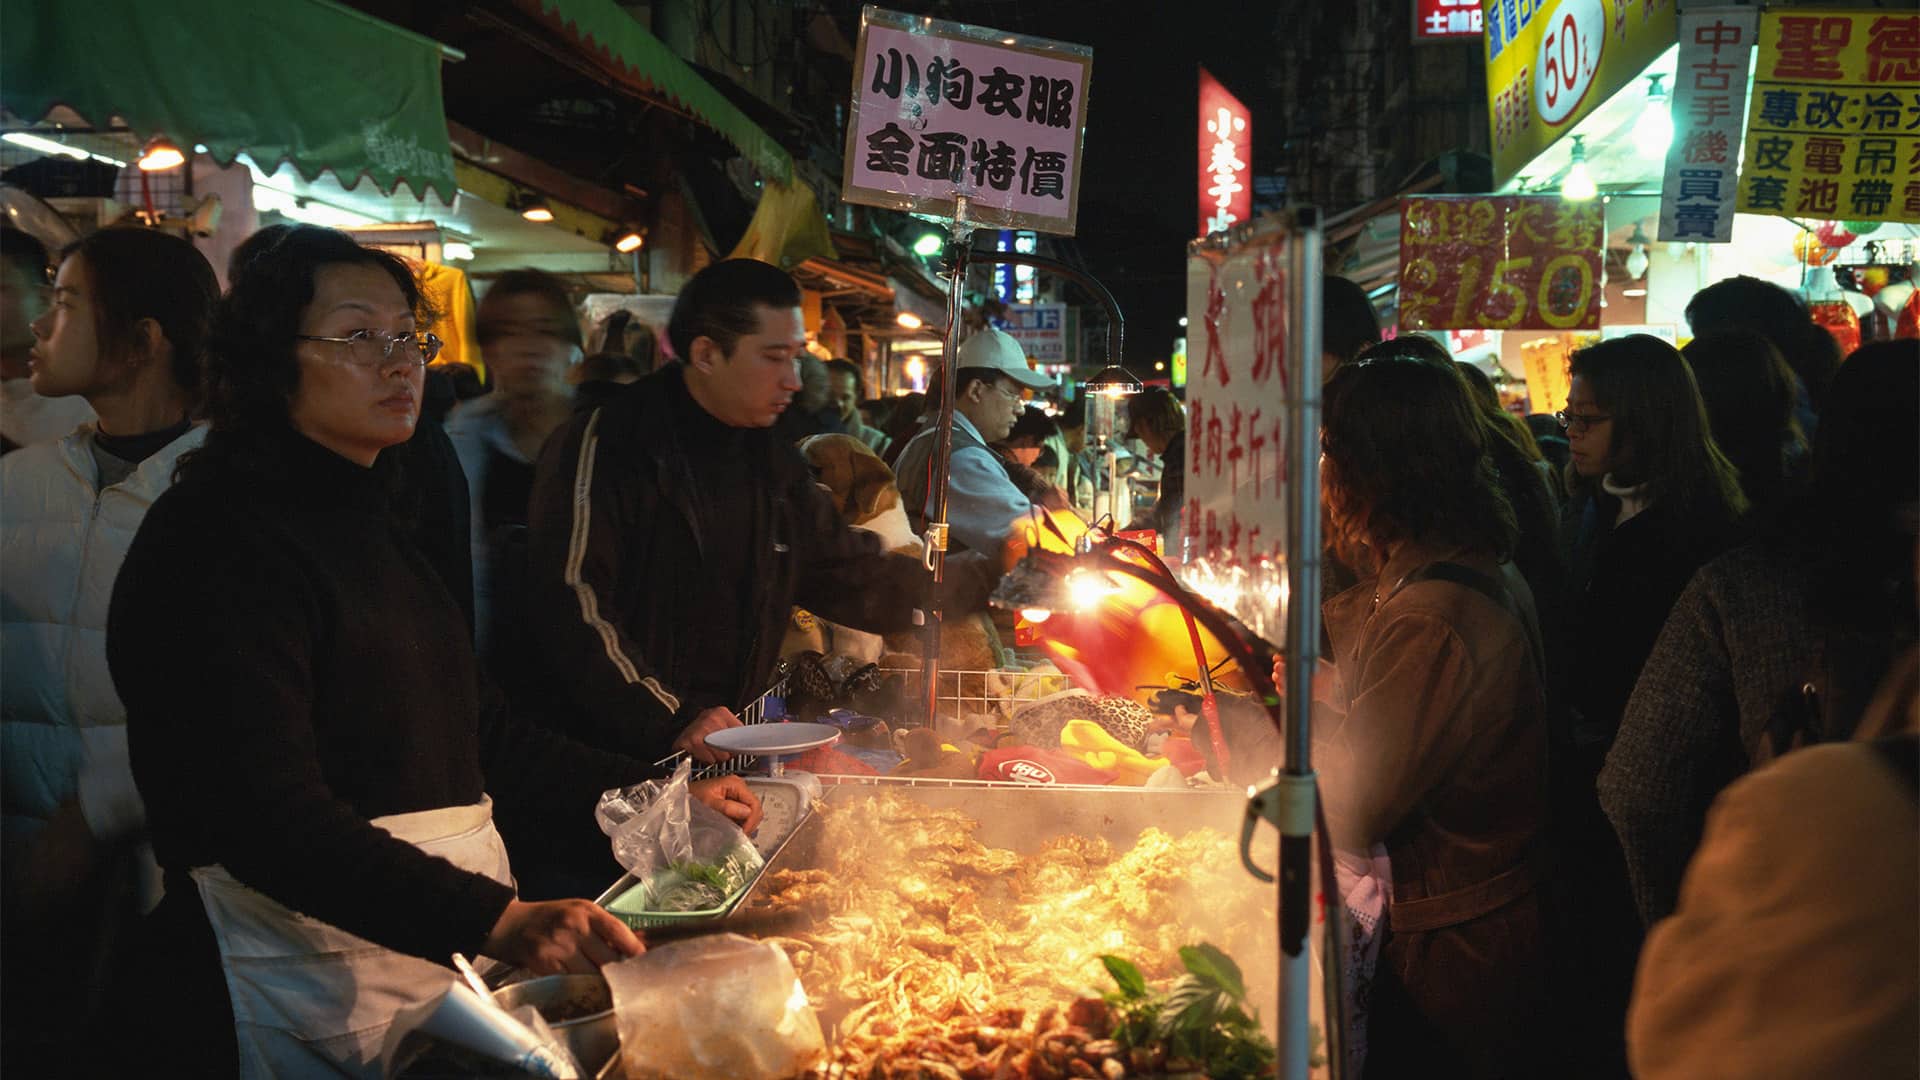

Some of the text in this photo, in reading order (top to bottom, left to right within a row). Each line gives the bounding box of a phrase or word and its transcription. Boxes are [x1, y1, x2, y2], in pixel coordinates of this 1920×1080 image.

[871, 47, 1074, 130] 小狗衣服
[1674, 19, 1742, 239] 中古手機買賣
[865, 122, 1068, 201] 全面特價
